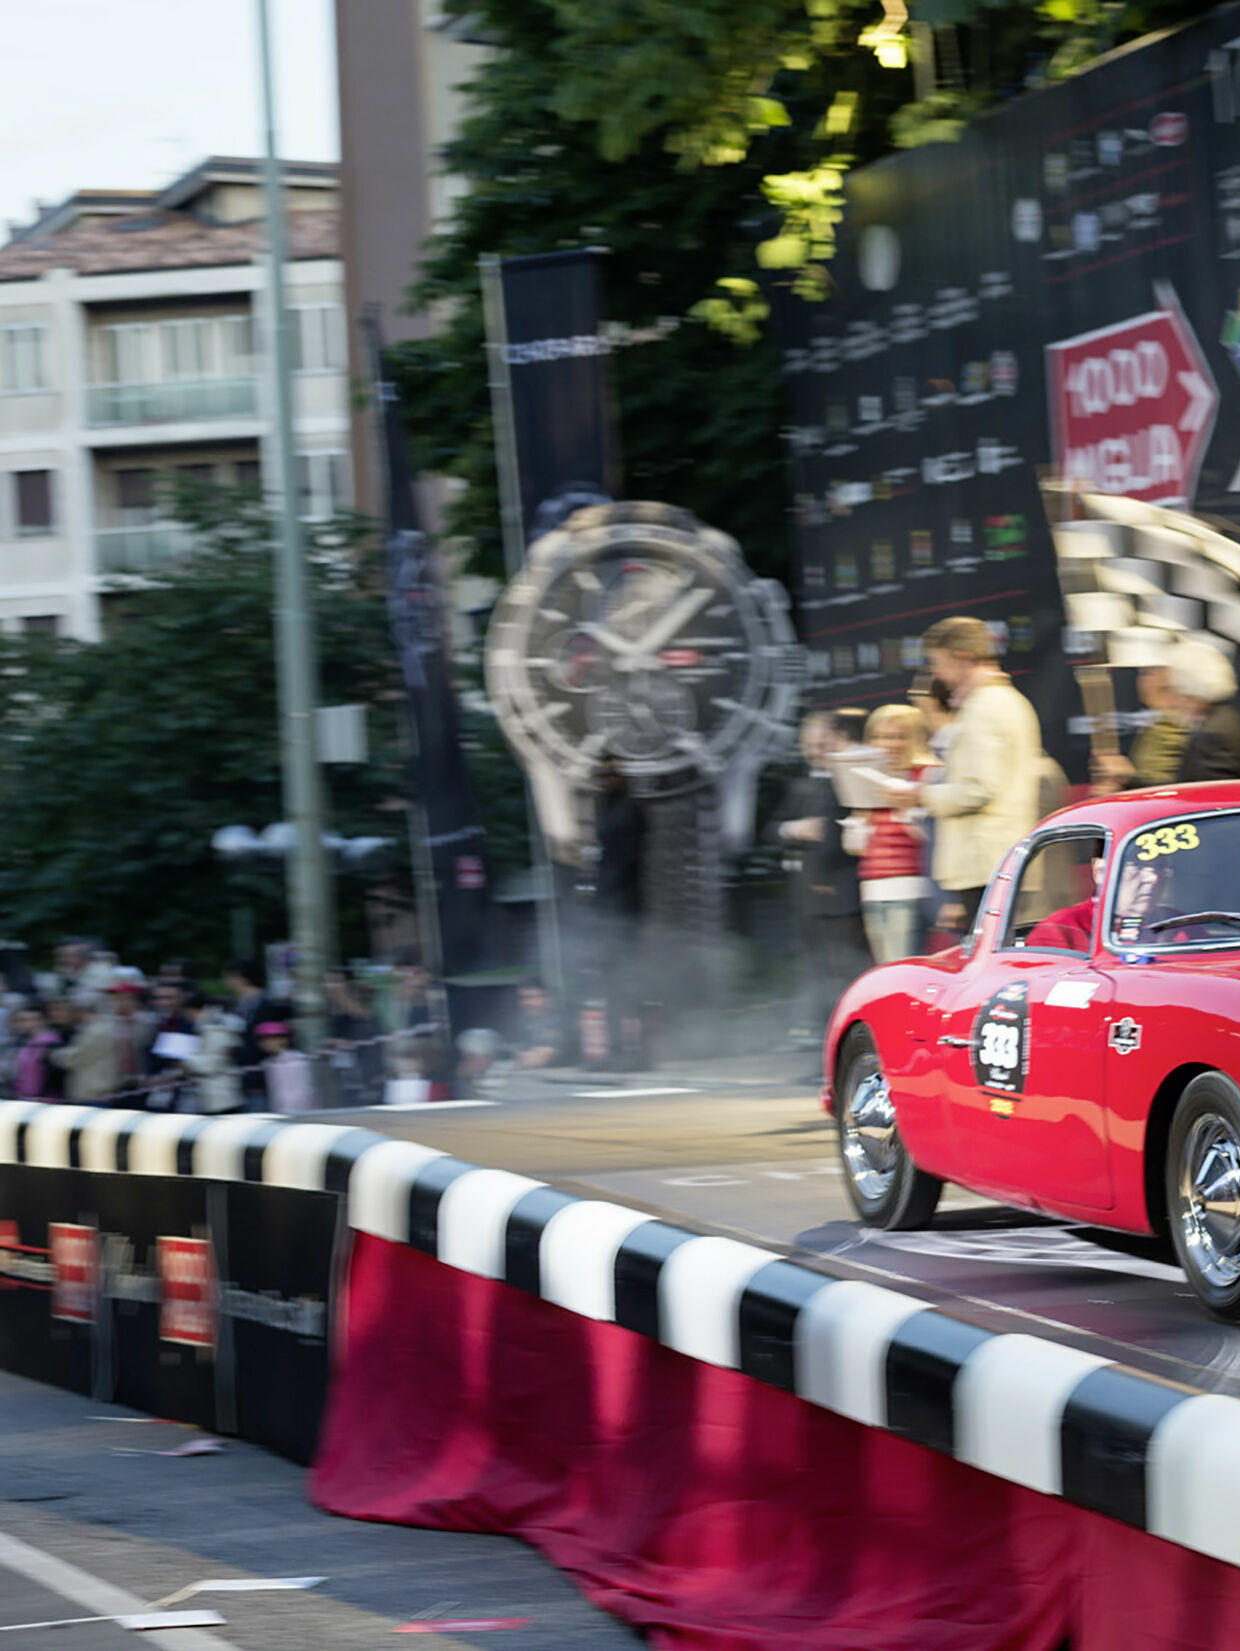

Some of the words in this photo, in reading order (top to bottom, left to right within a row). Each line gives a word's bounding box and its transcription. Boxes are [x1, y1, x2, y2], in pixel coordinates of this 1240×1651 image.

[1066, 340, 1169, 418] 1000
[1065, 424, 1183, 492] MIGLIA
[1135, 823, 1200, 861] 333
